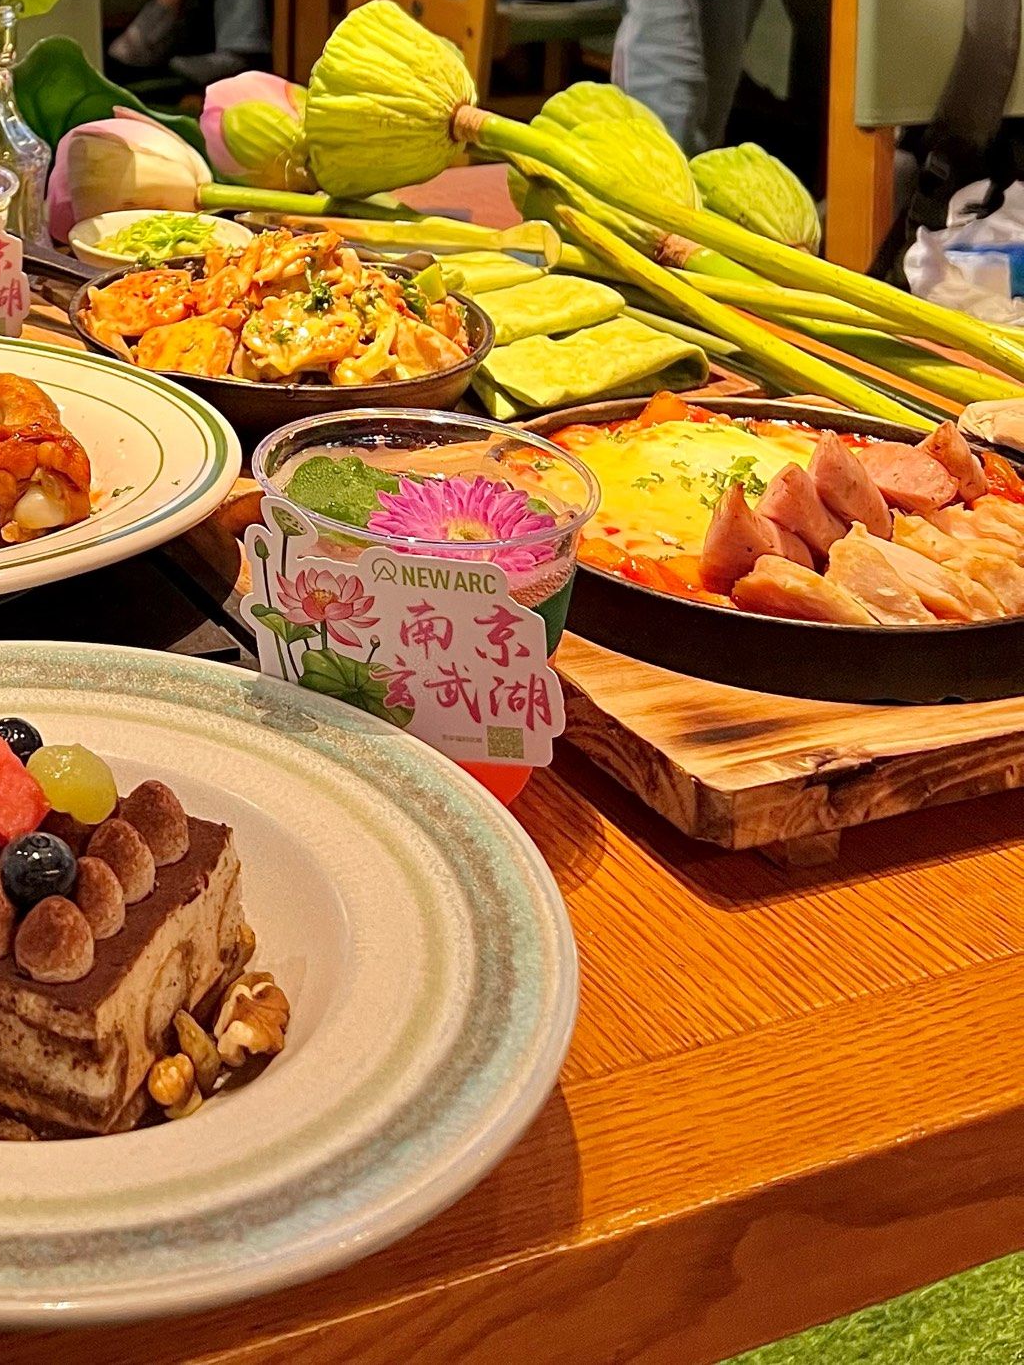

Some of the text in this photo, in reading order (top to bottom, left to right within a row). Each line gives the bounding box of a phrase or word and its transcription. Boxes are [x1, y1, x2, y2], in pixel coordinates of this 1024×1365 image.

[399, 599, 531, 667] 南京
[369, 654, 552, 731] 玄武湖
